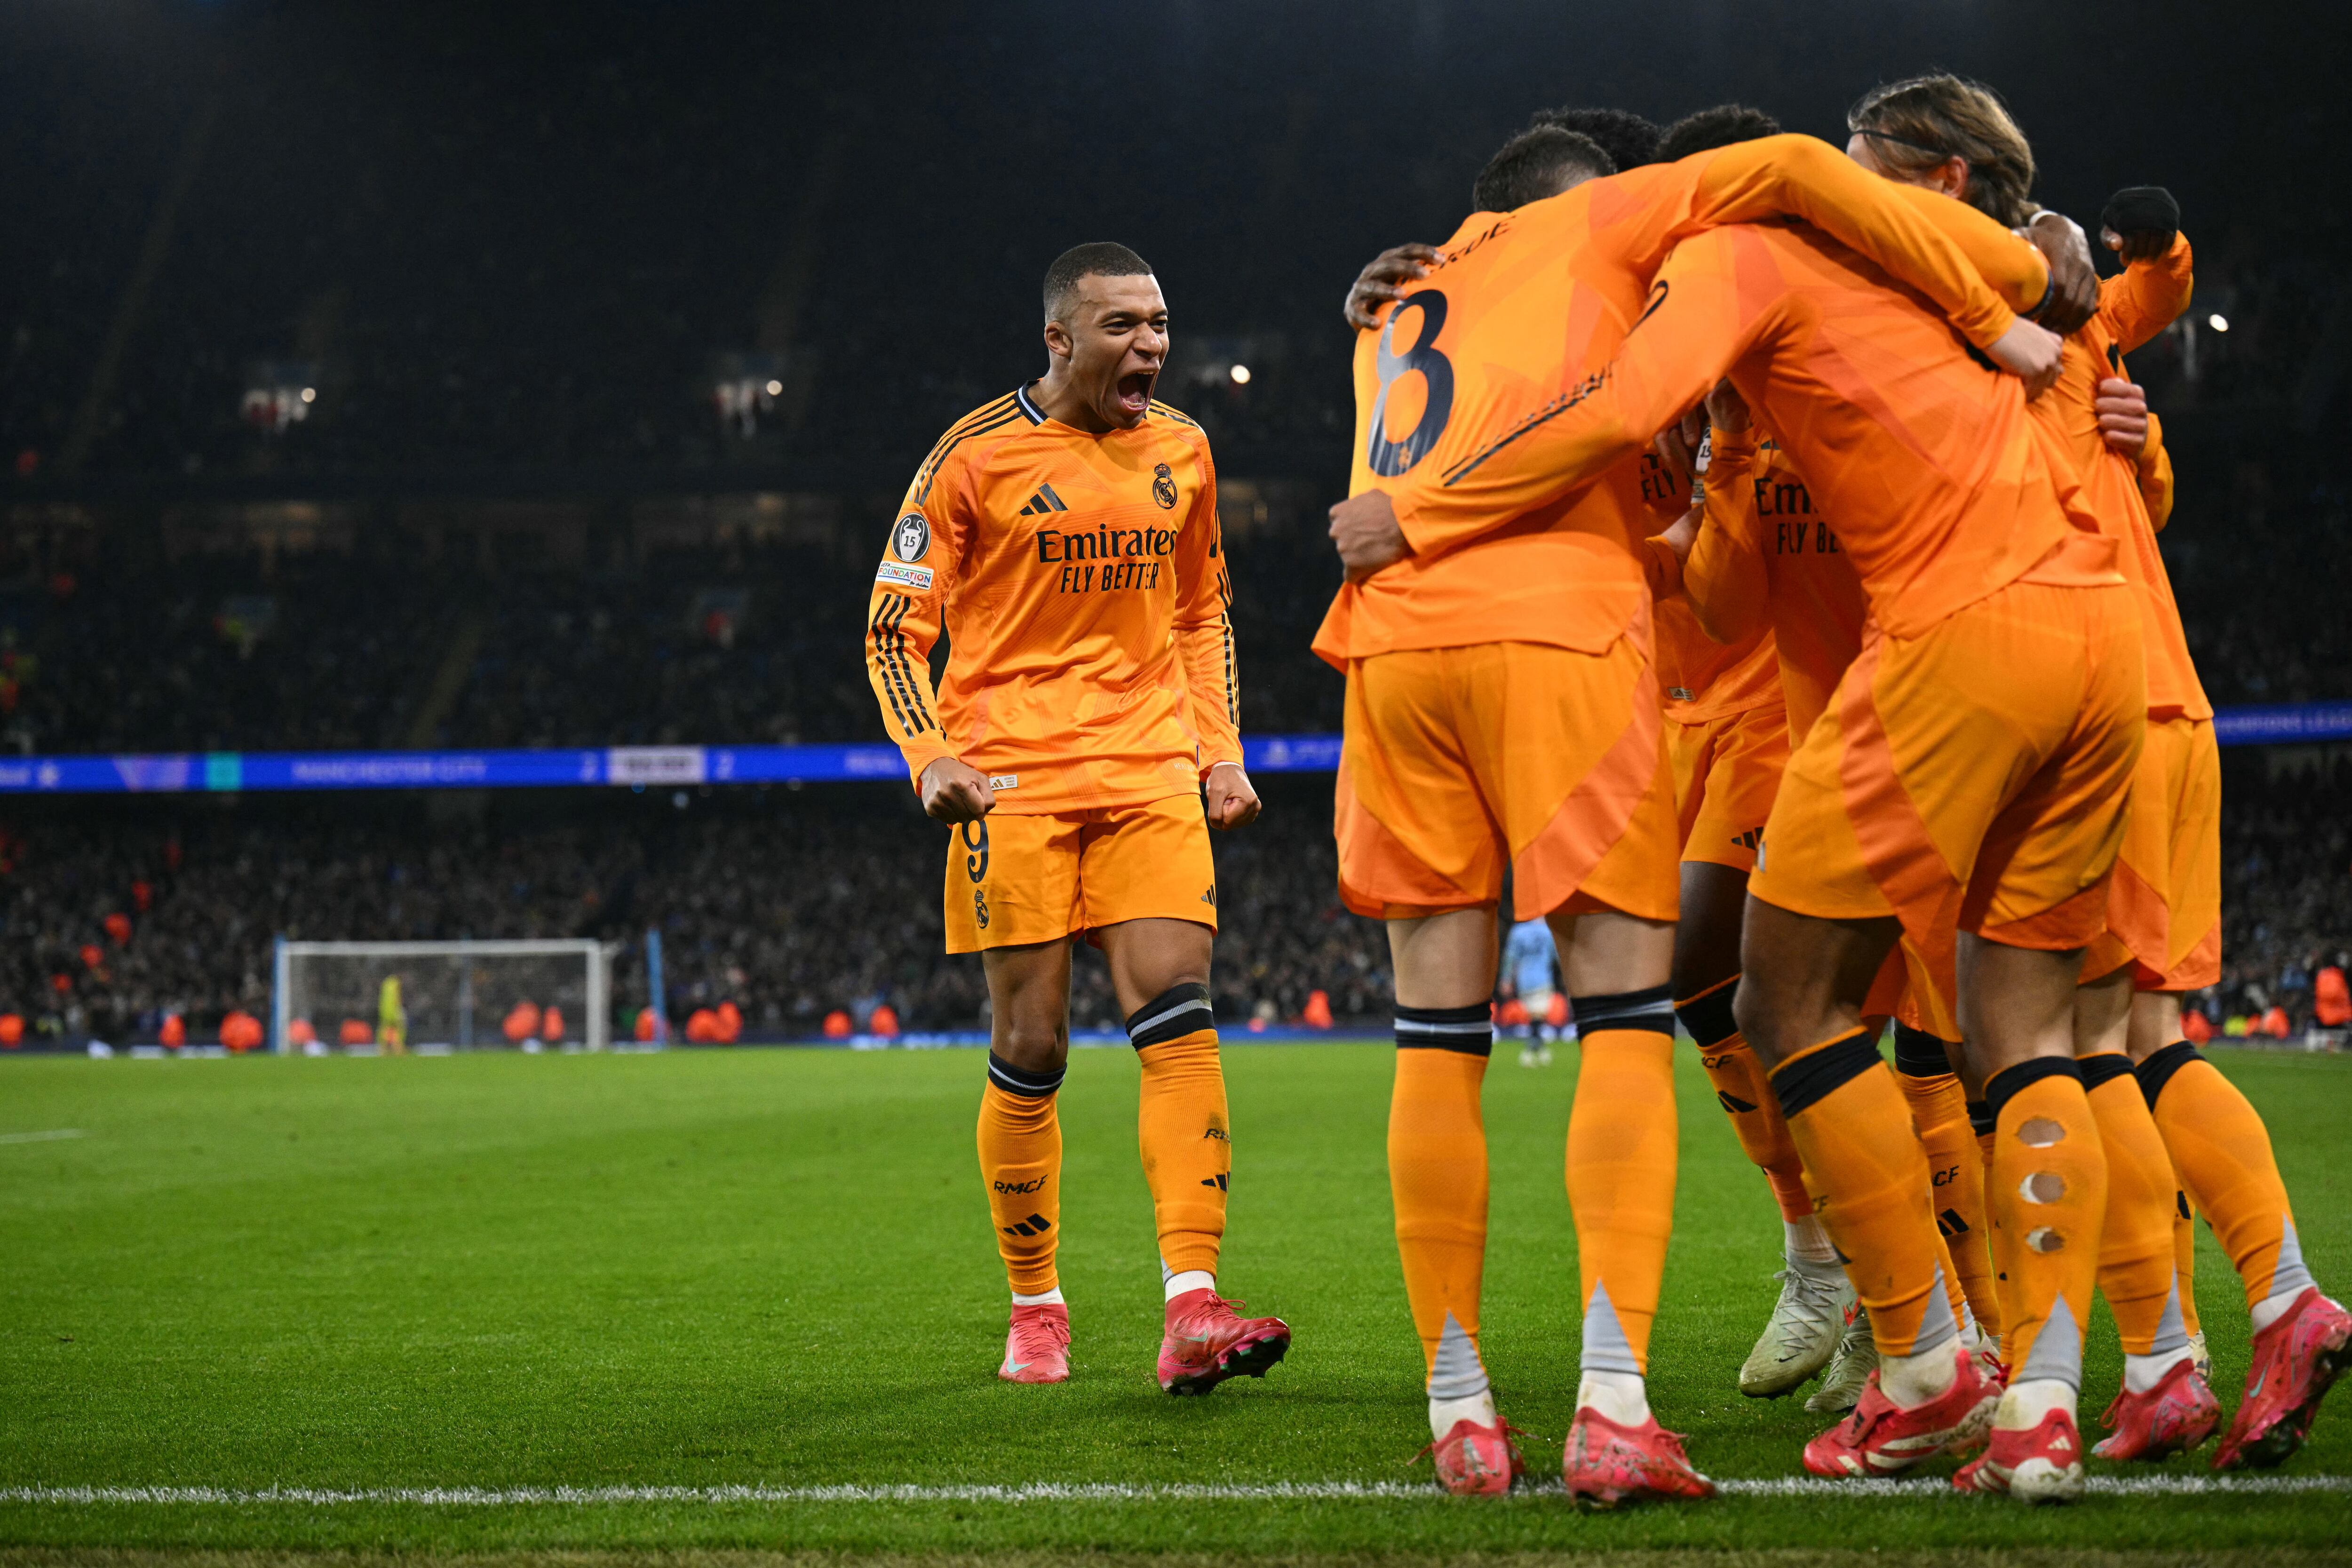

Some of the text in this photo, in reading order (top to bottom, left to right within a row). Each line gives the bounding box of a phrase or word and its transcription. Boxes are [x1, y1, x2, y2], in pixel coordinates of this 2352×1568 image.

[1368, 289, 1454, 477] 8
[904, 535, 916, 547] 15
[1036, 523, 1177, 563] Emirates
[1778, 523, 1808, 555] FLY
[878, 567, 931, 583] FOUNDATION
[1061, 563, 1159, 593] FLY BETTER
[961, 820, 989, 883] 9
[1701, 1054, 1734, 1069] CF
[994, 1174, 1048, 1194] RMCF
[1933, 1165, 1959, 1186] CF
